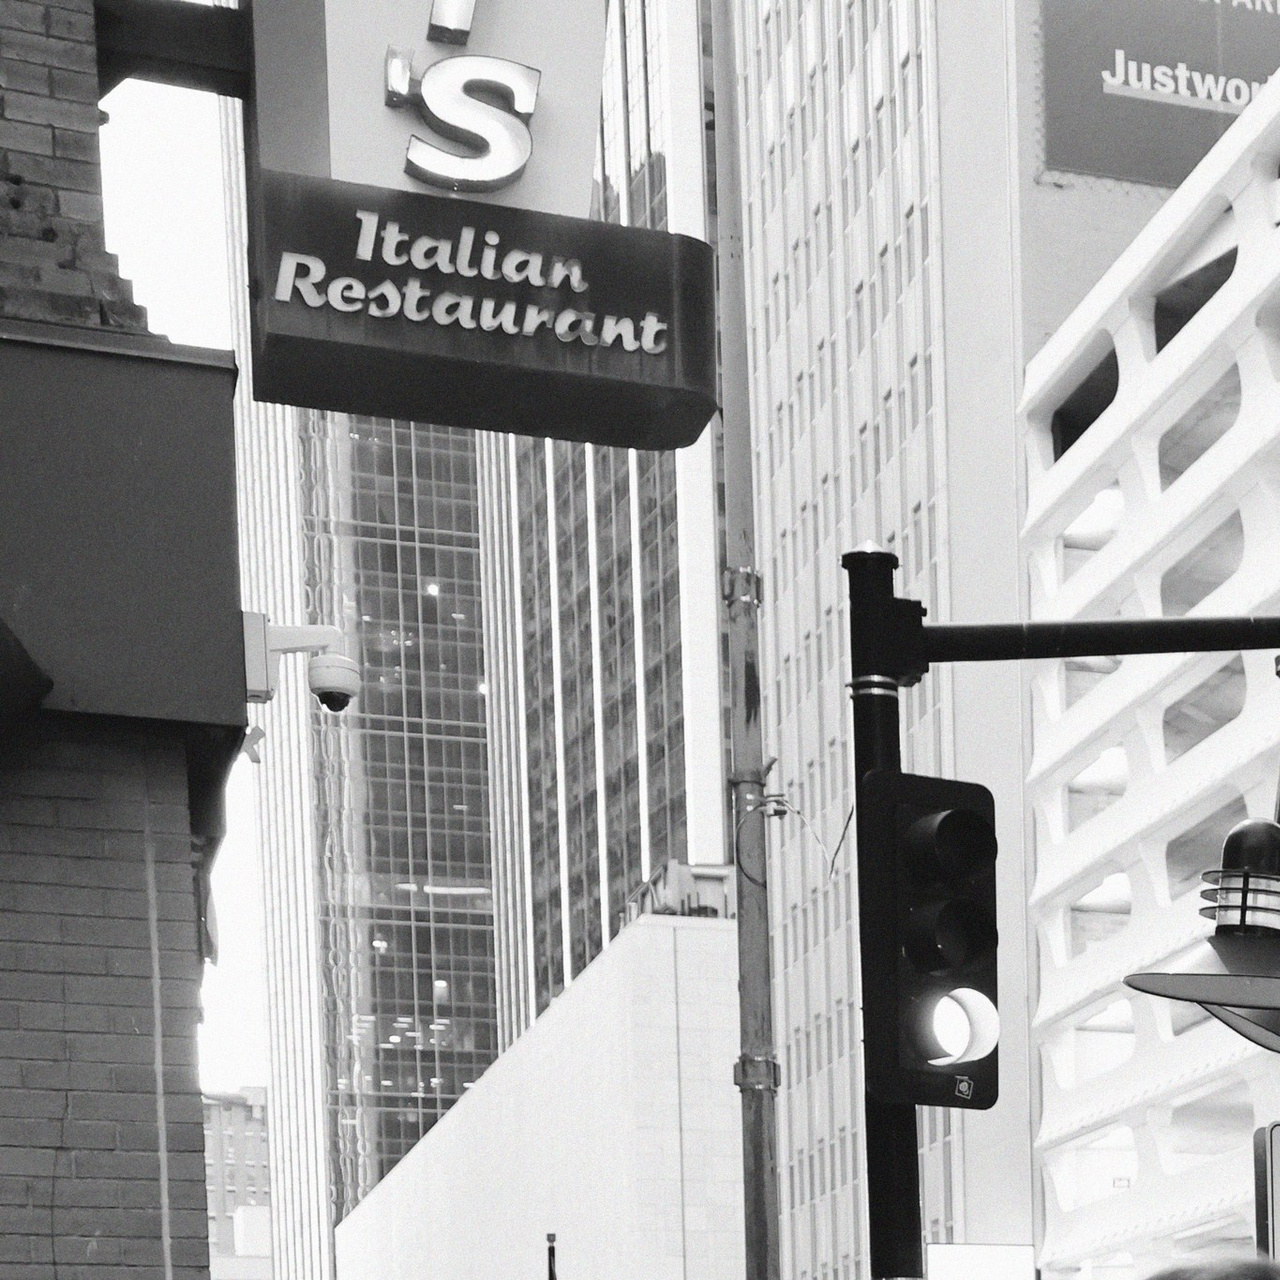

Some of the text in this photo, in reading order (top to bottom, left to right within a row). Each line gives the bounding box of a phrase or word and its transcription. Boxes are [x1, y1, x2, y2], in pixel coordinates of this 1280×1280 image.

[1101, 48, 1274, 107] Justwor
[354, 210, 588, 292] Italian
[274, 252, 667, 354] Restaurant
